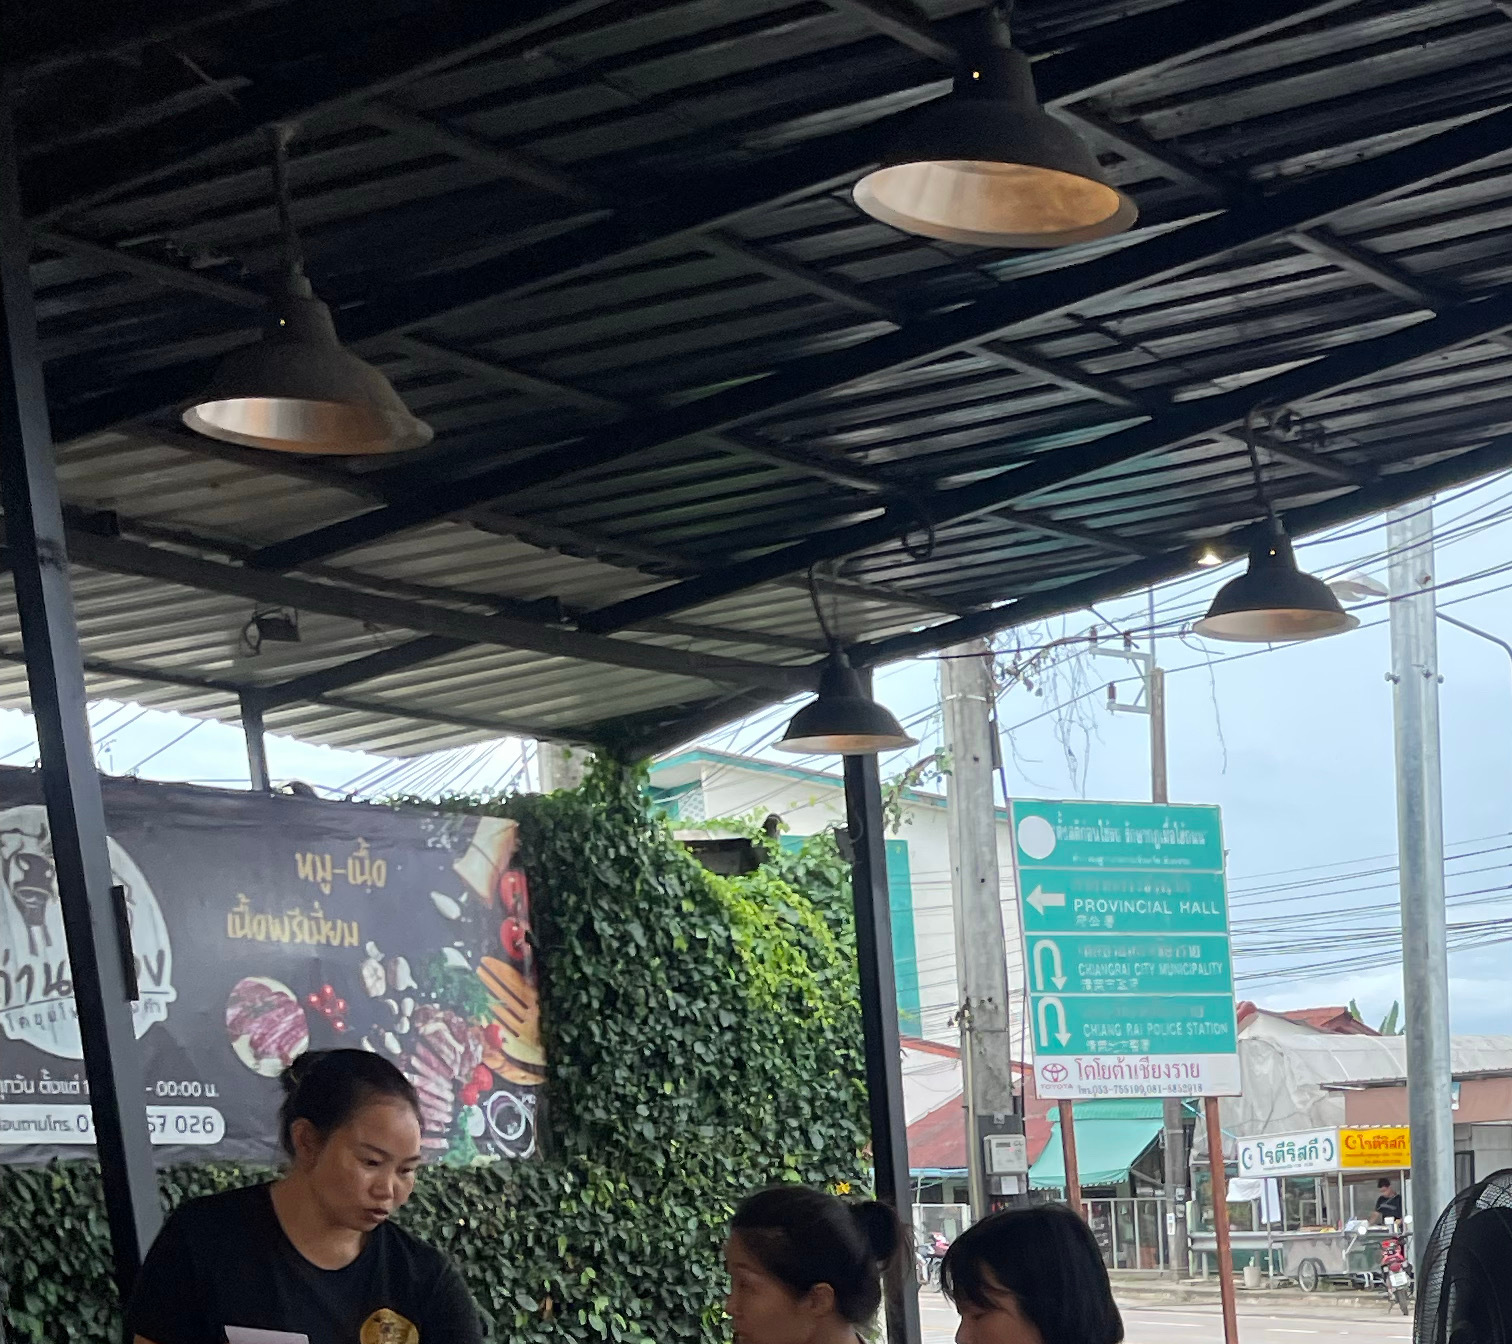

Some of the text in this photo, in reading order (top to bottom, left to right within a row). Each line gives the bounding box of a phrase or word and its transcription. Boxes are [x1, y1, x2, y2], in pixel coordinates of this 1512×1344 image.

[1073, 898, 1221, 915] PROVINCIAL HALL
[1083, 1022, 1229, 1037] CHIANG RAI POLICE STATION
[1074, 1056, 1201, 1081] โตโยต้าเชียงราย
[156, 1080, 202, 1097] 00:00
[1040, 1083, 1074, 1091] TOYOTA
[175, 1114, 215, 1134] 026
